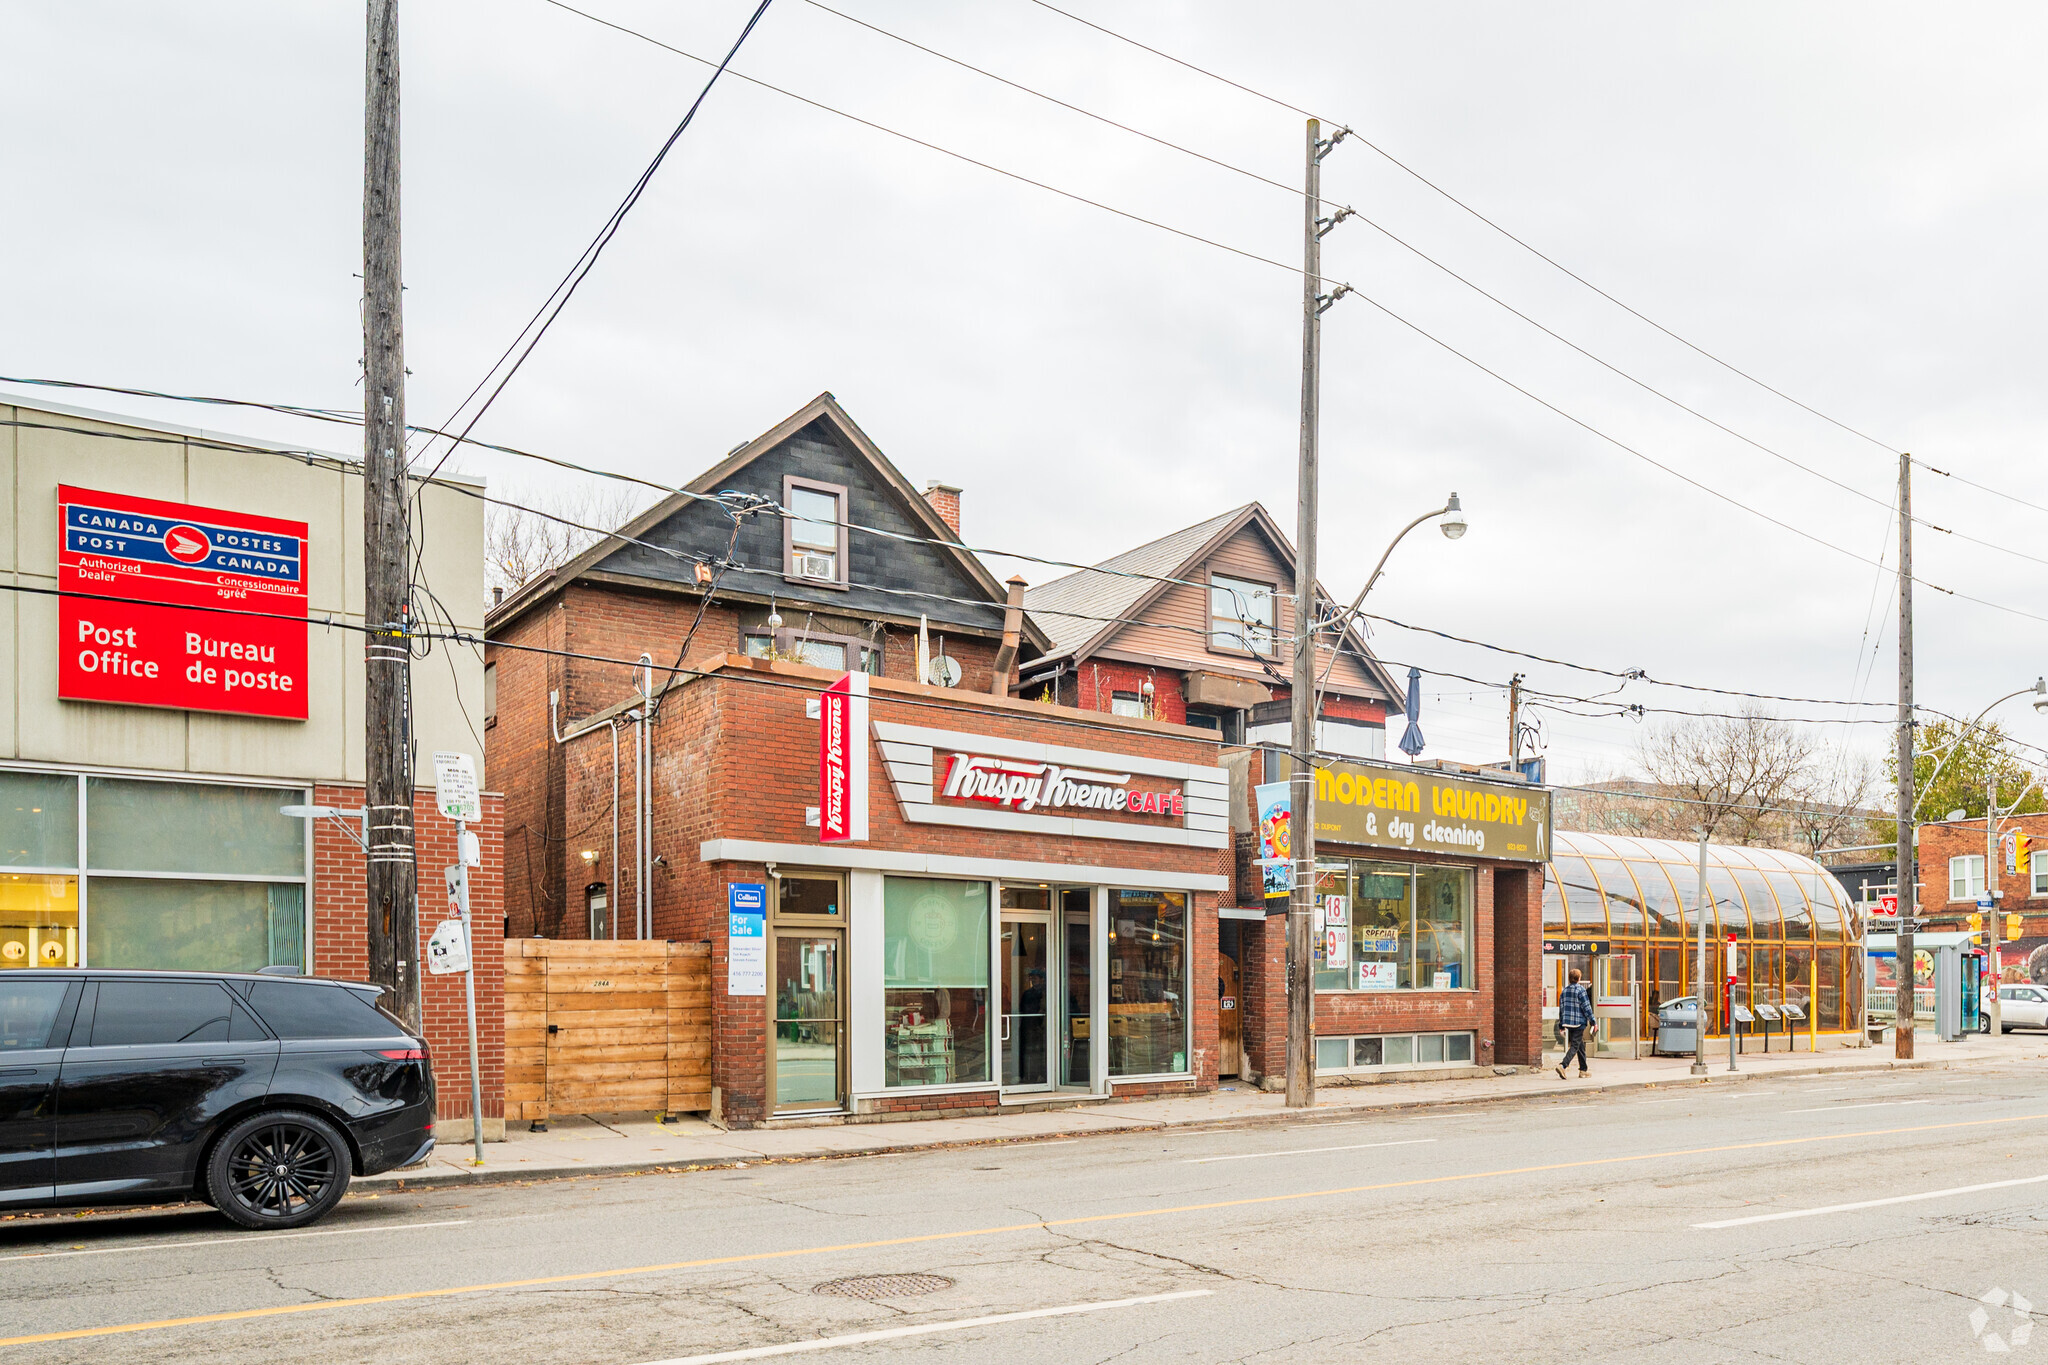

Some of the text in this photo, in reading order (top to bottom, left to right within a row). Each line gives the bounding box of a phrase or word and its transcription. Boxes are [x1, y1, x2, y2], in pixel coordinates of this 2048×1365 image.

[78, 513, 158, 534] CANADA
[78, 535, 126, 551] POST
[216, 533, 281, 552] POSTES
[78, 557, 141, 573] Authorized
[216, 555, 290, 574] CANADA
[78, 568, 116, 582] Dealer
[216, 575, 299, 594] Concessionnaire
[216, 588, 247, 599] agréé
[78, 619, 137, 648] Post
[185, 631, 275, 664] Bureau
[78, 649, 159, 678] Office
[185, 660, 293, 692] de poste
[827, 695, 845, 834] Krispy Kreme
[943, 753, 1185, 816] Krispy Kreme CAFÉ
[1314, 767, 1527, 826] MODERN LAUNDRY
[1320, 822, 1342, 832] DUPONT
[1365, 812, 1485, 852] & dry cleaning
[1315, 873, 1335, 888] IALS
[737, 893, 758, 901] Colliers
[1327, 896, 1340, 917] 18
[732, 914, 748, 924] For
[732, 925, 752, 935] Sale
[1365, 929, 1396, 939] SPECIAL
[1375, 940, 1397, 952] SHIRTS
[1559, 943, 1585, 951] DUPONT
[1361, 964, 1377, 979] $4
